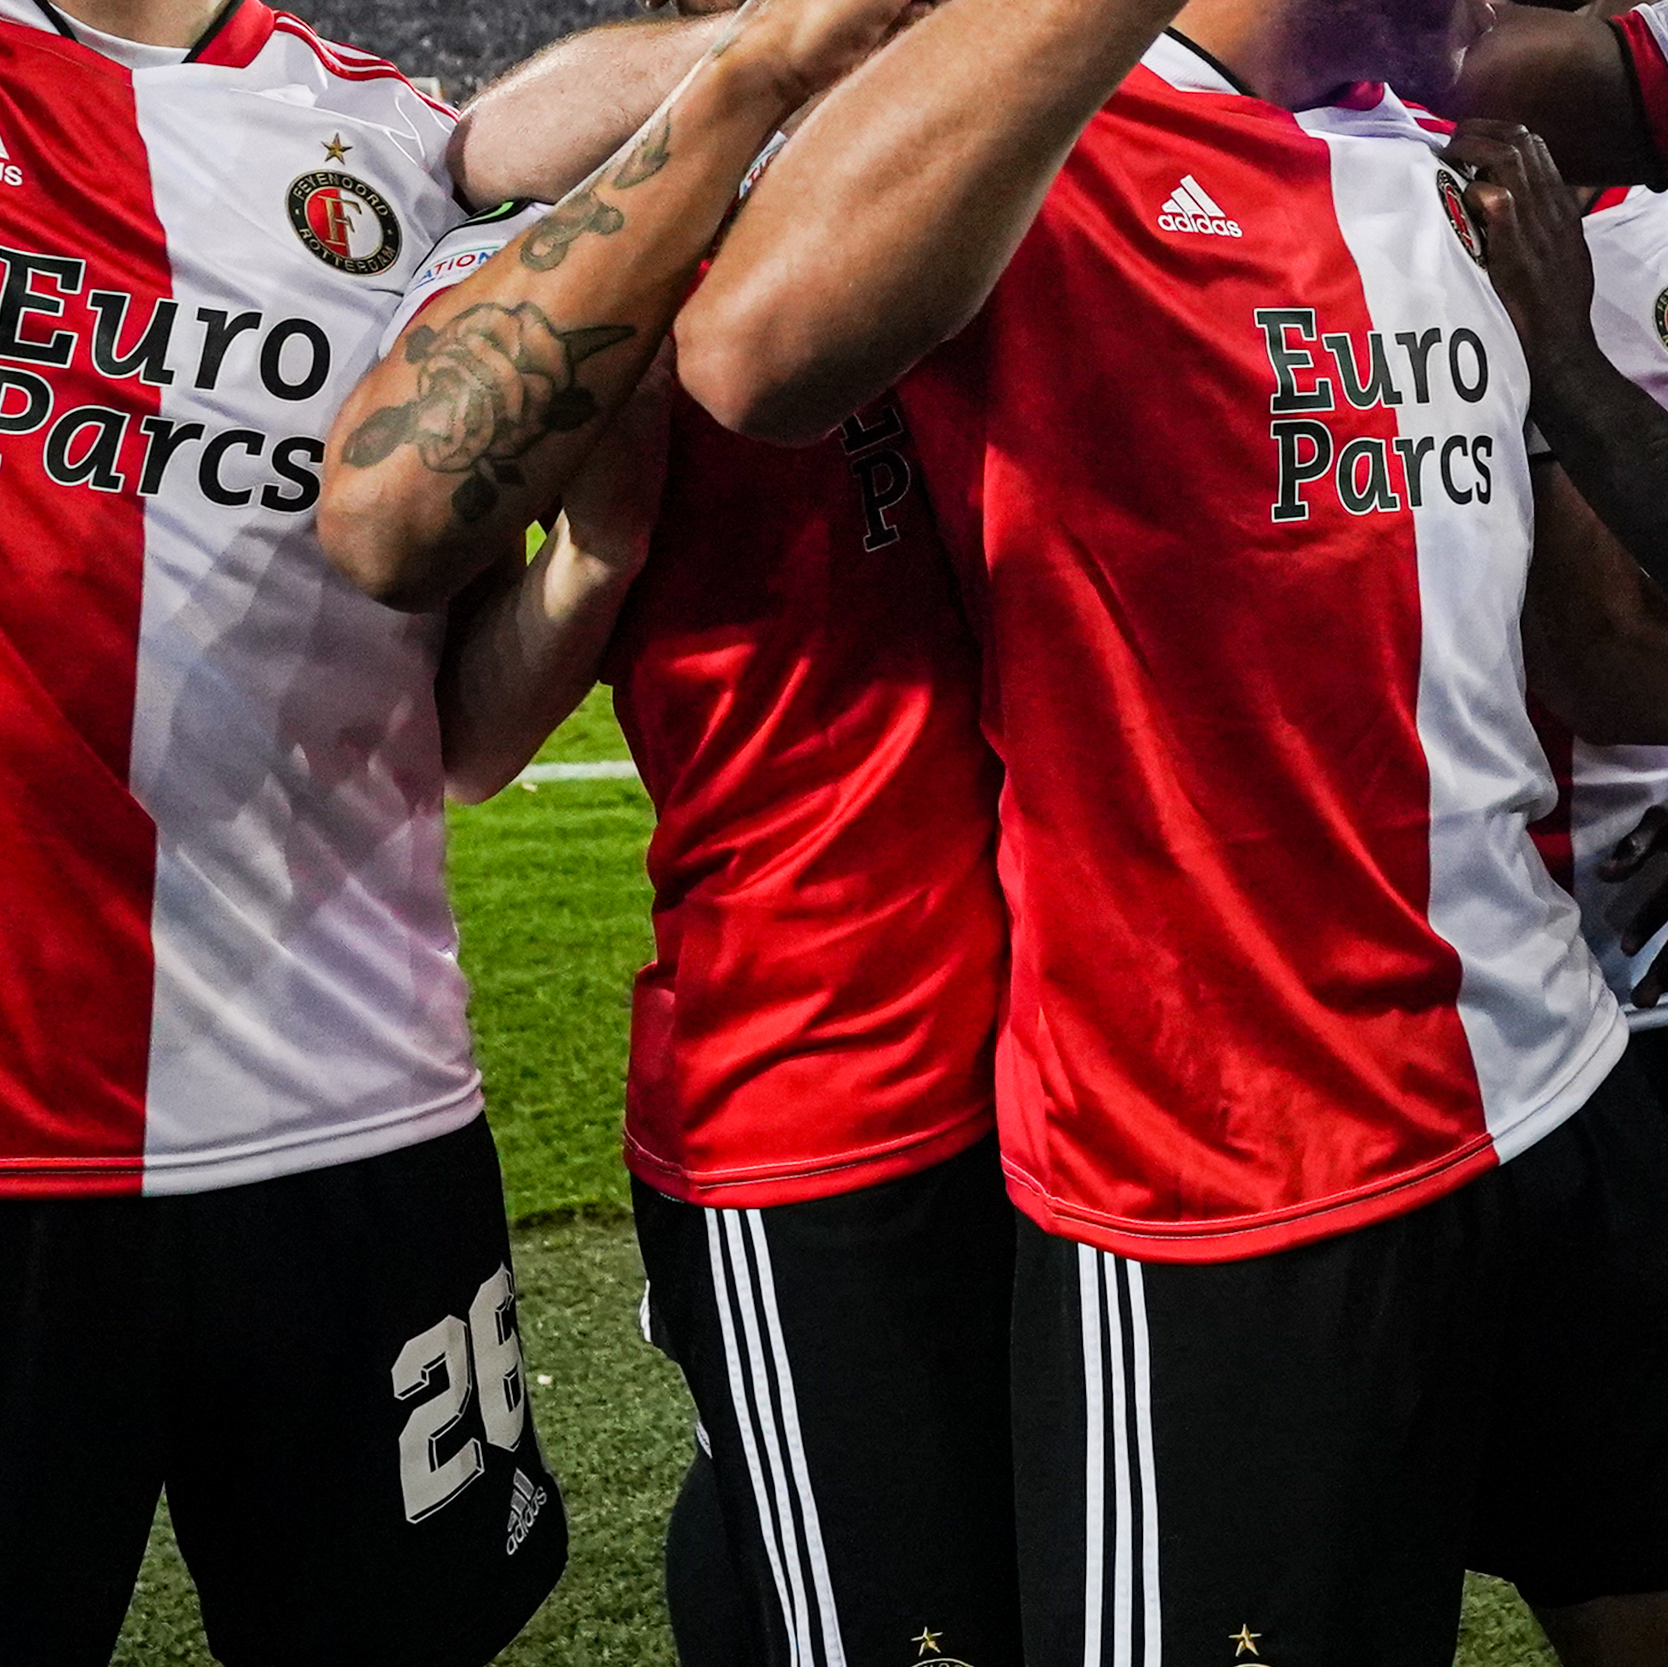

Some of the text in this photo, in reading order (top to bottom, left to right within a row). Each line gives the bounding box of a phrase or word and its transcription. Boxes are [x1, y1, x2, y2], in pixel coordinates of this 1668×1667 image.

[293, 174, 389, 216] FEYENOORD
[1157, 214, 1243, 238] adidas
[299, 228, 396, 271] ROTTERDAM
[1254, 307, 1489, 414] Euro
[1270, 419, 1493, 523] Parcs
[391, 1262, 527, 1524] 26
[506, 1486, 548, 1555] adidas
